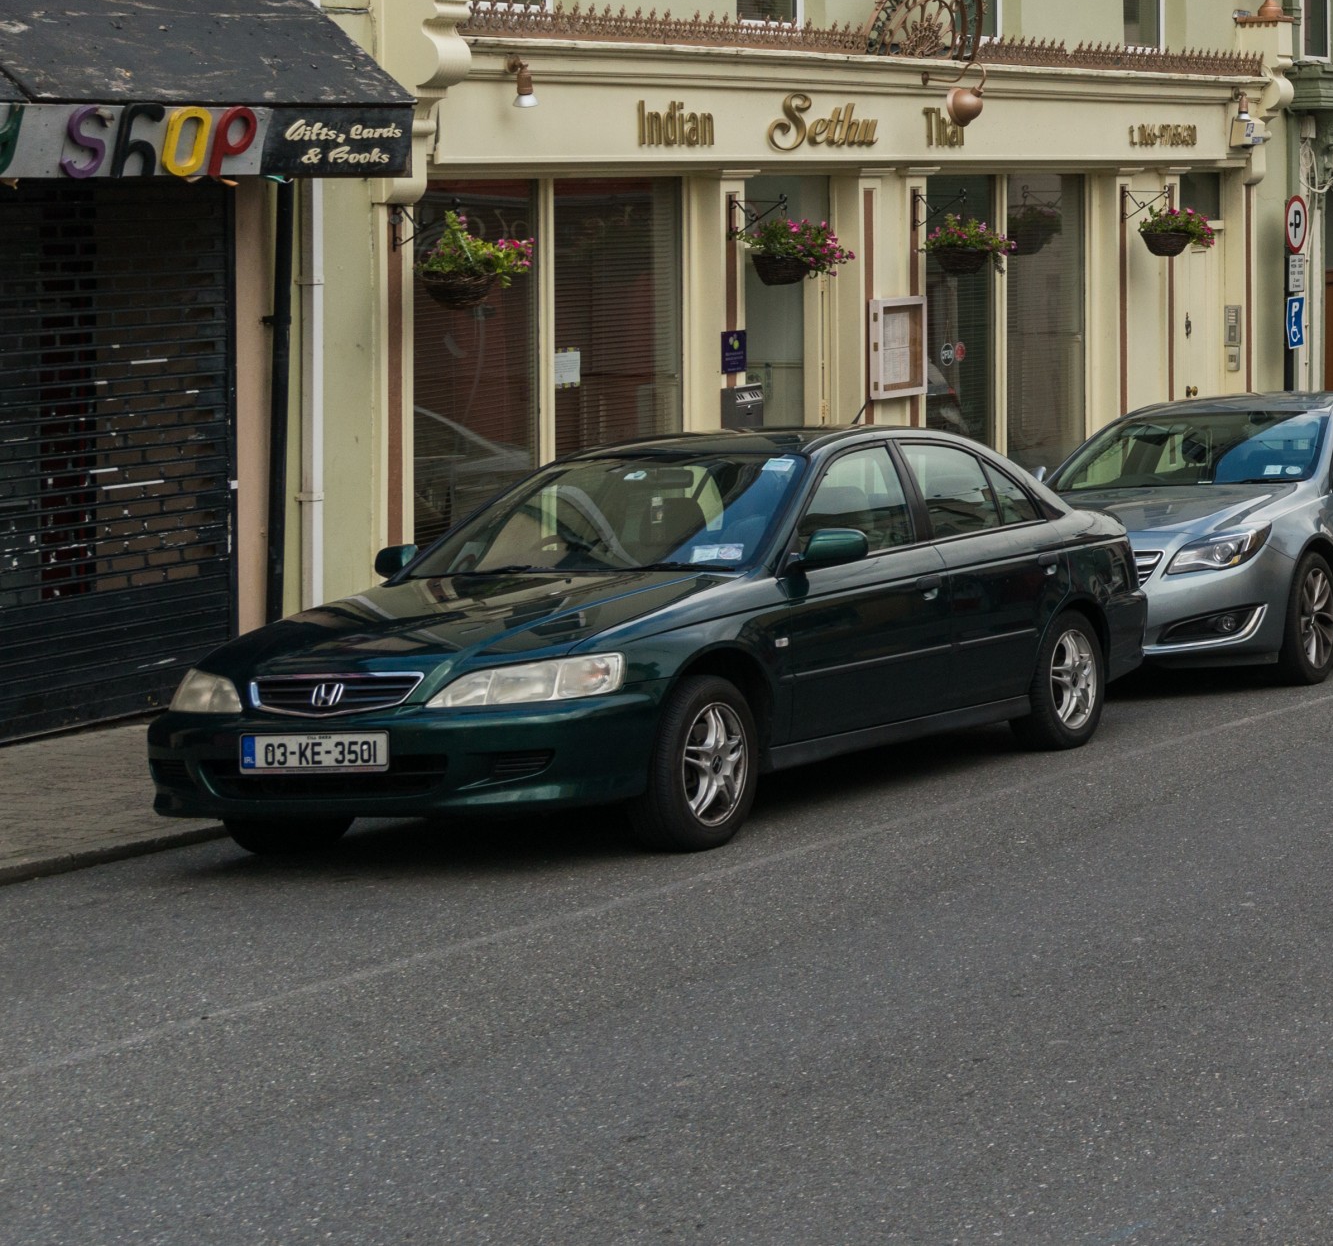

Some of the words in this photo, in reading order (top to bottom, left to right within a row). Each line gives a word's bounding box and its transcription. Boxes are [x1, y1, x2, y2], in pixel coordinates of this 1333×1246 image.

[350, 122, 402, 140] Cards
[637, 99, 714, 147] Indian
[768, 92, 879, 152] Sethu
[923, 106, 966, 147] Thai
[301, 148, 319, 164] &
[328, 145, 390, 164] Books
[1294, 210, 1301, 239] P
[1292, 302, 1299, 316] P
[265, 740, 377, 766] 03-KE-3501
